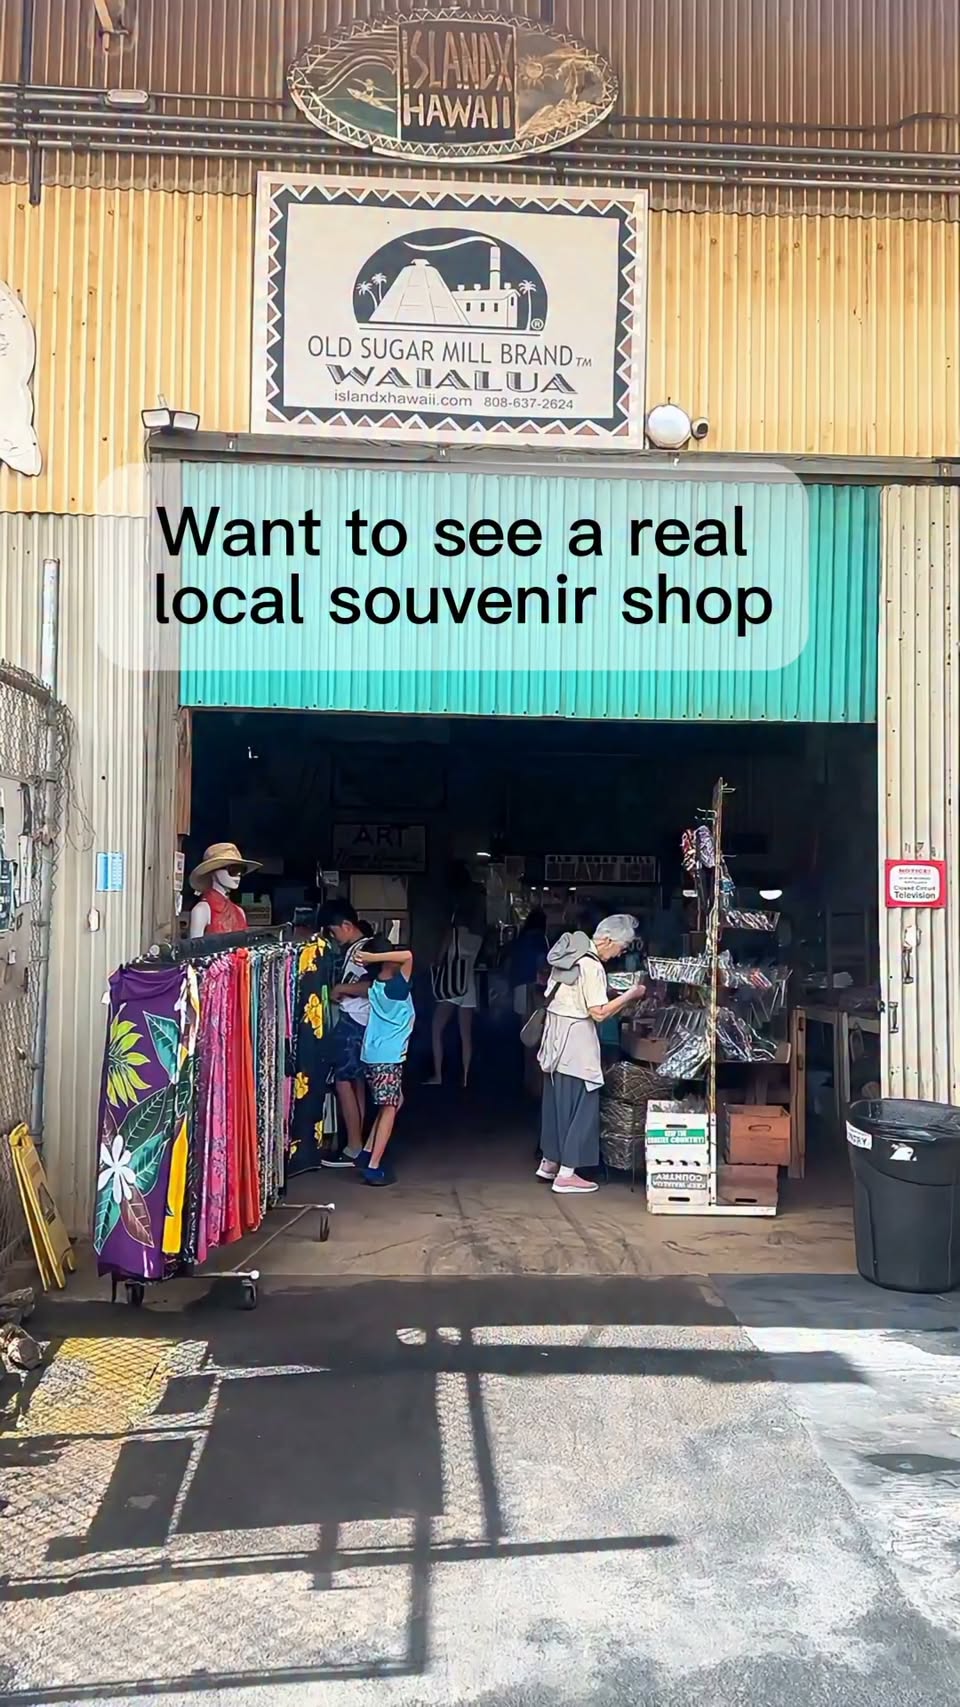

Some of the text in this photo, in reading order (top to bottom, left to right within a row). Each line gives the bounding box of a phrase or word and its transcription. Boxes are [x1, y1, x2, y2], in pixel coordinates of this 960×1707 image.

[403, 93, 511, 128] HAWAII
[307, 335, 352, 358] OLD
[361, 337, 434, 362] SUGAR
[442, 341, 492, 364] MILL
[325, 363, 579, 395] WAIALUA
[334, 391, 574, 410] islandxhawaii.com 808-637-2624
[352, 824, 408, 849] ART
[894, 891, 936, 899] Television
[656, 1173, 703, 1182] COUNTRY
